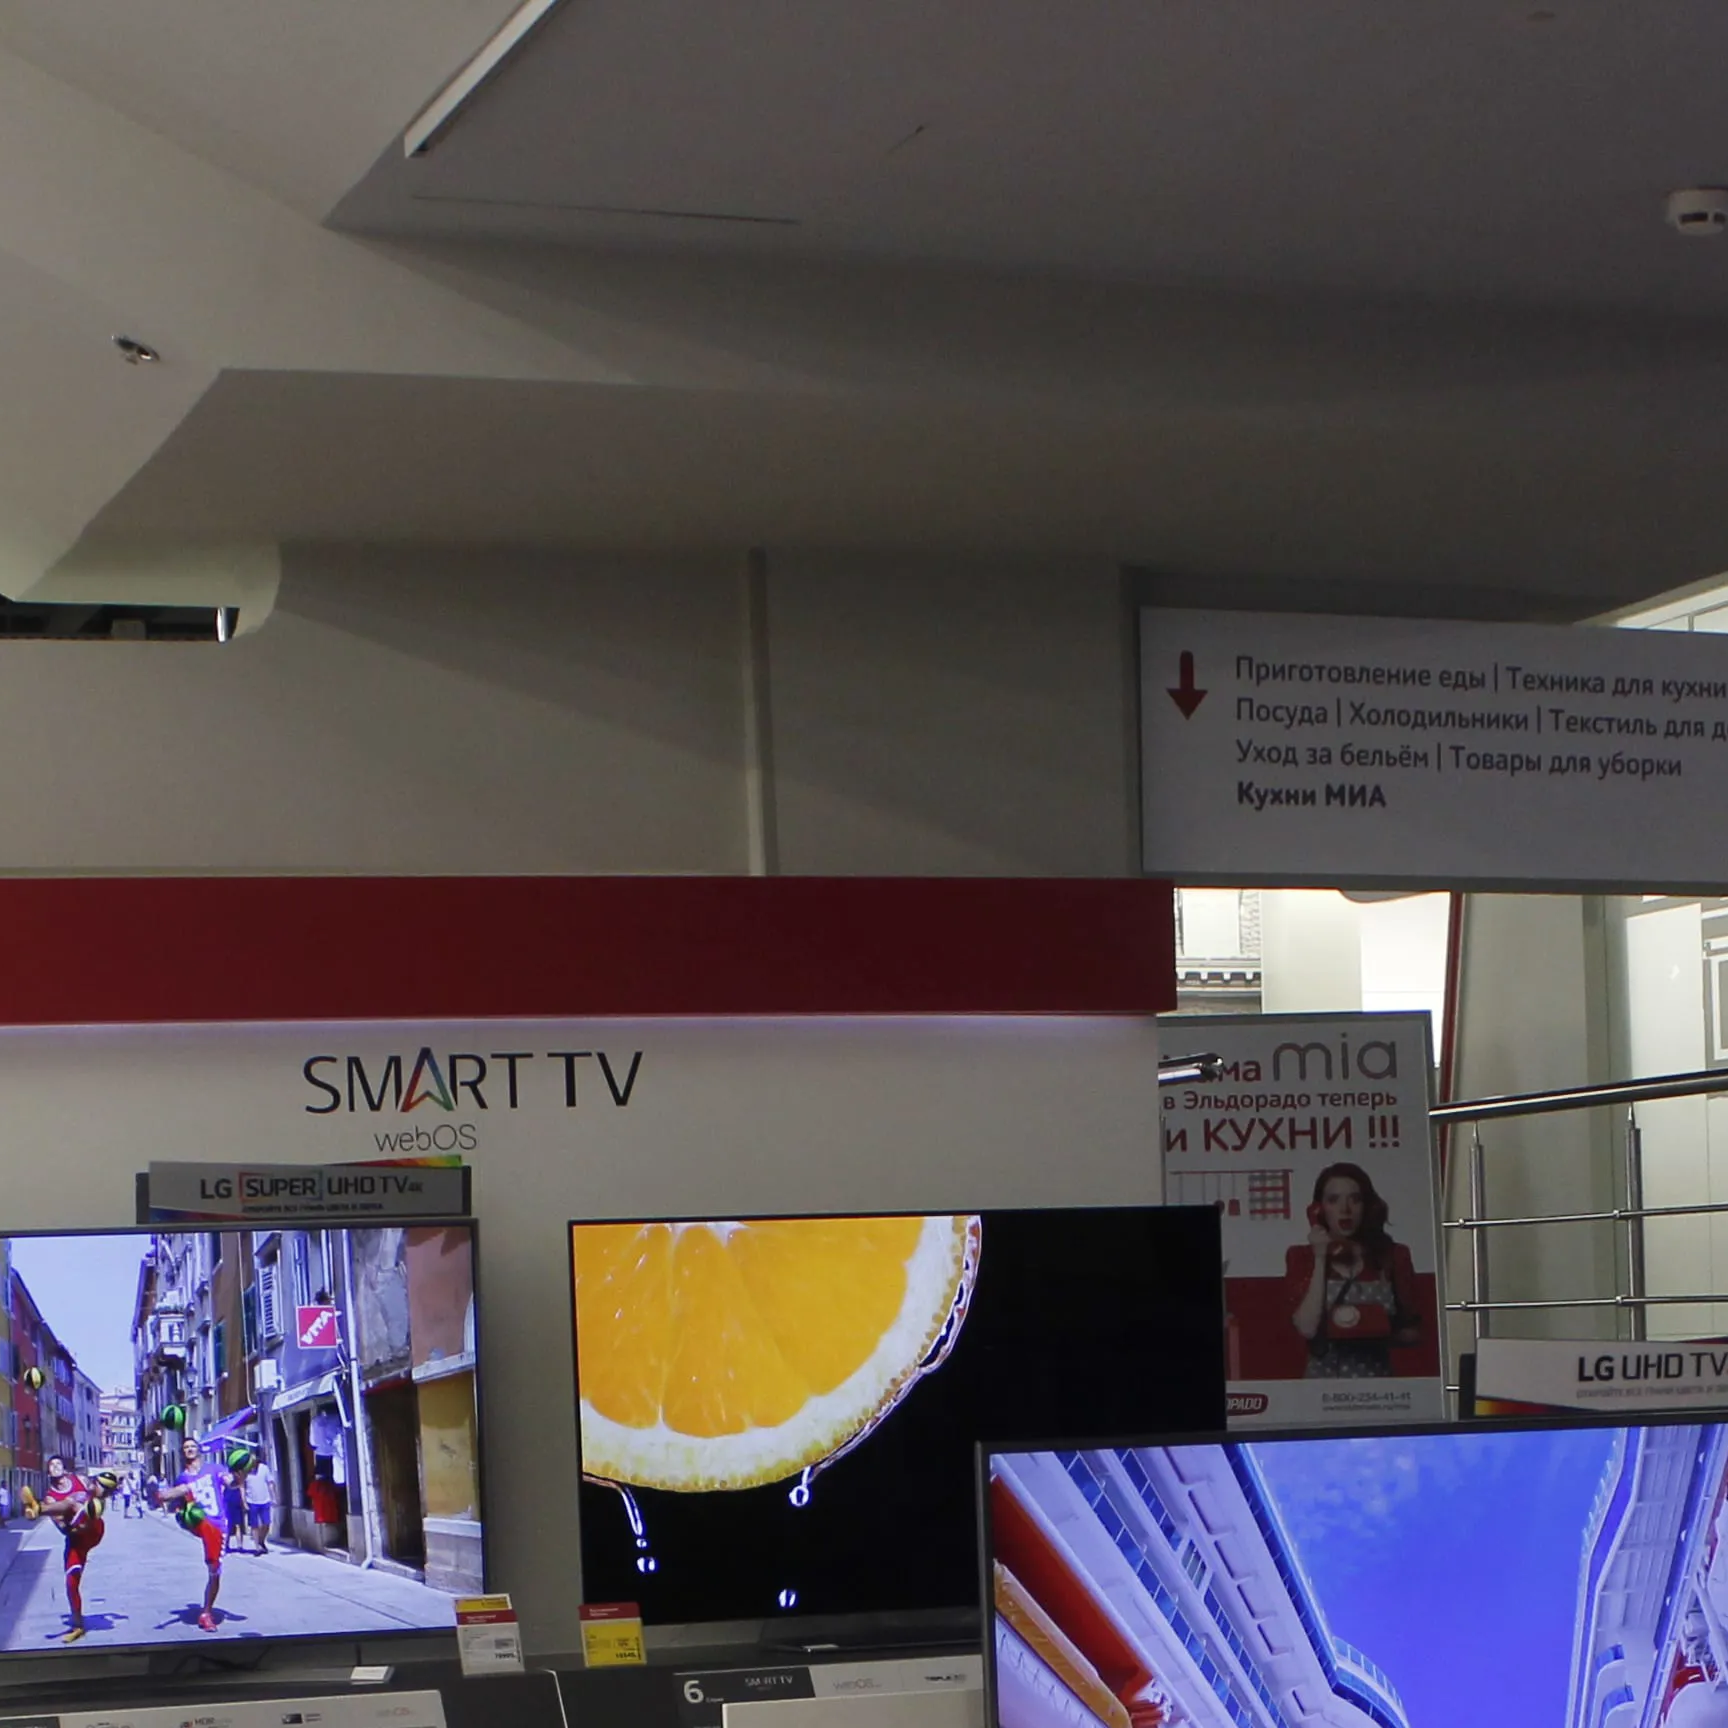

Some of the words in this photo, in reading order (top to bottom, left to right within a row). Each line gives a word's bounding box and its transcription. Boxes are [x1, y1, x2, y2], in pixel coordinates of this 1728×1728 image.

[1234, 655, 1432, 690] Приготовление
[1438, 666, 1487, 691] еды
[1505, 666, 1606, 695] Техника
[1612, 674, 1654, 698] для
[1660, 677, 1728, 704] кухни
[1235, 697, 1329, 728] Посуда
[1348, 700, 1530, 733] Холодильники
[1549, 708, 1657, 738] Текстиль
[1663, 715, 1706, 741] для
[1235, 739, 1298, 769] Уход
[1305, 745, 1333, 767] за
[1339, 741, 1430, 770] бельём
[1449, 745, 1542, 777] Товары
[1548, 752, 1591, 778] для
[1597, 749, 1683, 781] уборки
[1235, 781, 1318, 811] Кухни
[1323, 783, 1388, 809] МИА
[1272, 1032, 1398, 1081] mia
[302, 1046, 535, 1114] SMART
[547, 1050, 643, 1108] TV
[1163, 1095, 1176, 1111] в
[1183, 1090, 1311, 1113] Эльдорадо
[1317, 1092, 1398, 1112] теперь
[373, 1123, 478, 1153] webOS
[1166, 1128, 1188, 1153] и
[1203, 1116, 1352, 1153] КУХНИ
[200, 1178, 233, 1200] LG
[244, 1177, 317, 1198] SUPER
[327, 1176, 375, 1196] UHD
[1577, 1355, 1615, 1382] LG
[1622, 1353, 1683, 1381] UHD
[682, 1679, 705, 1704] 6
